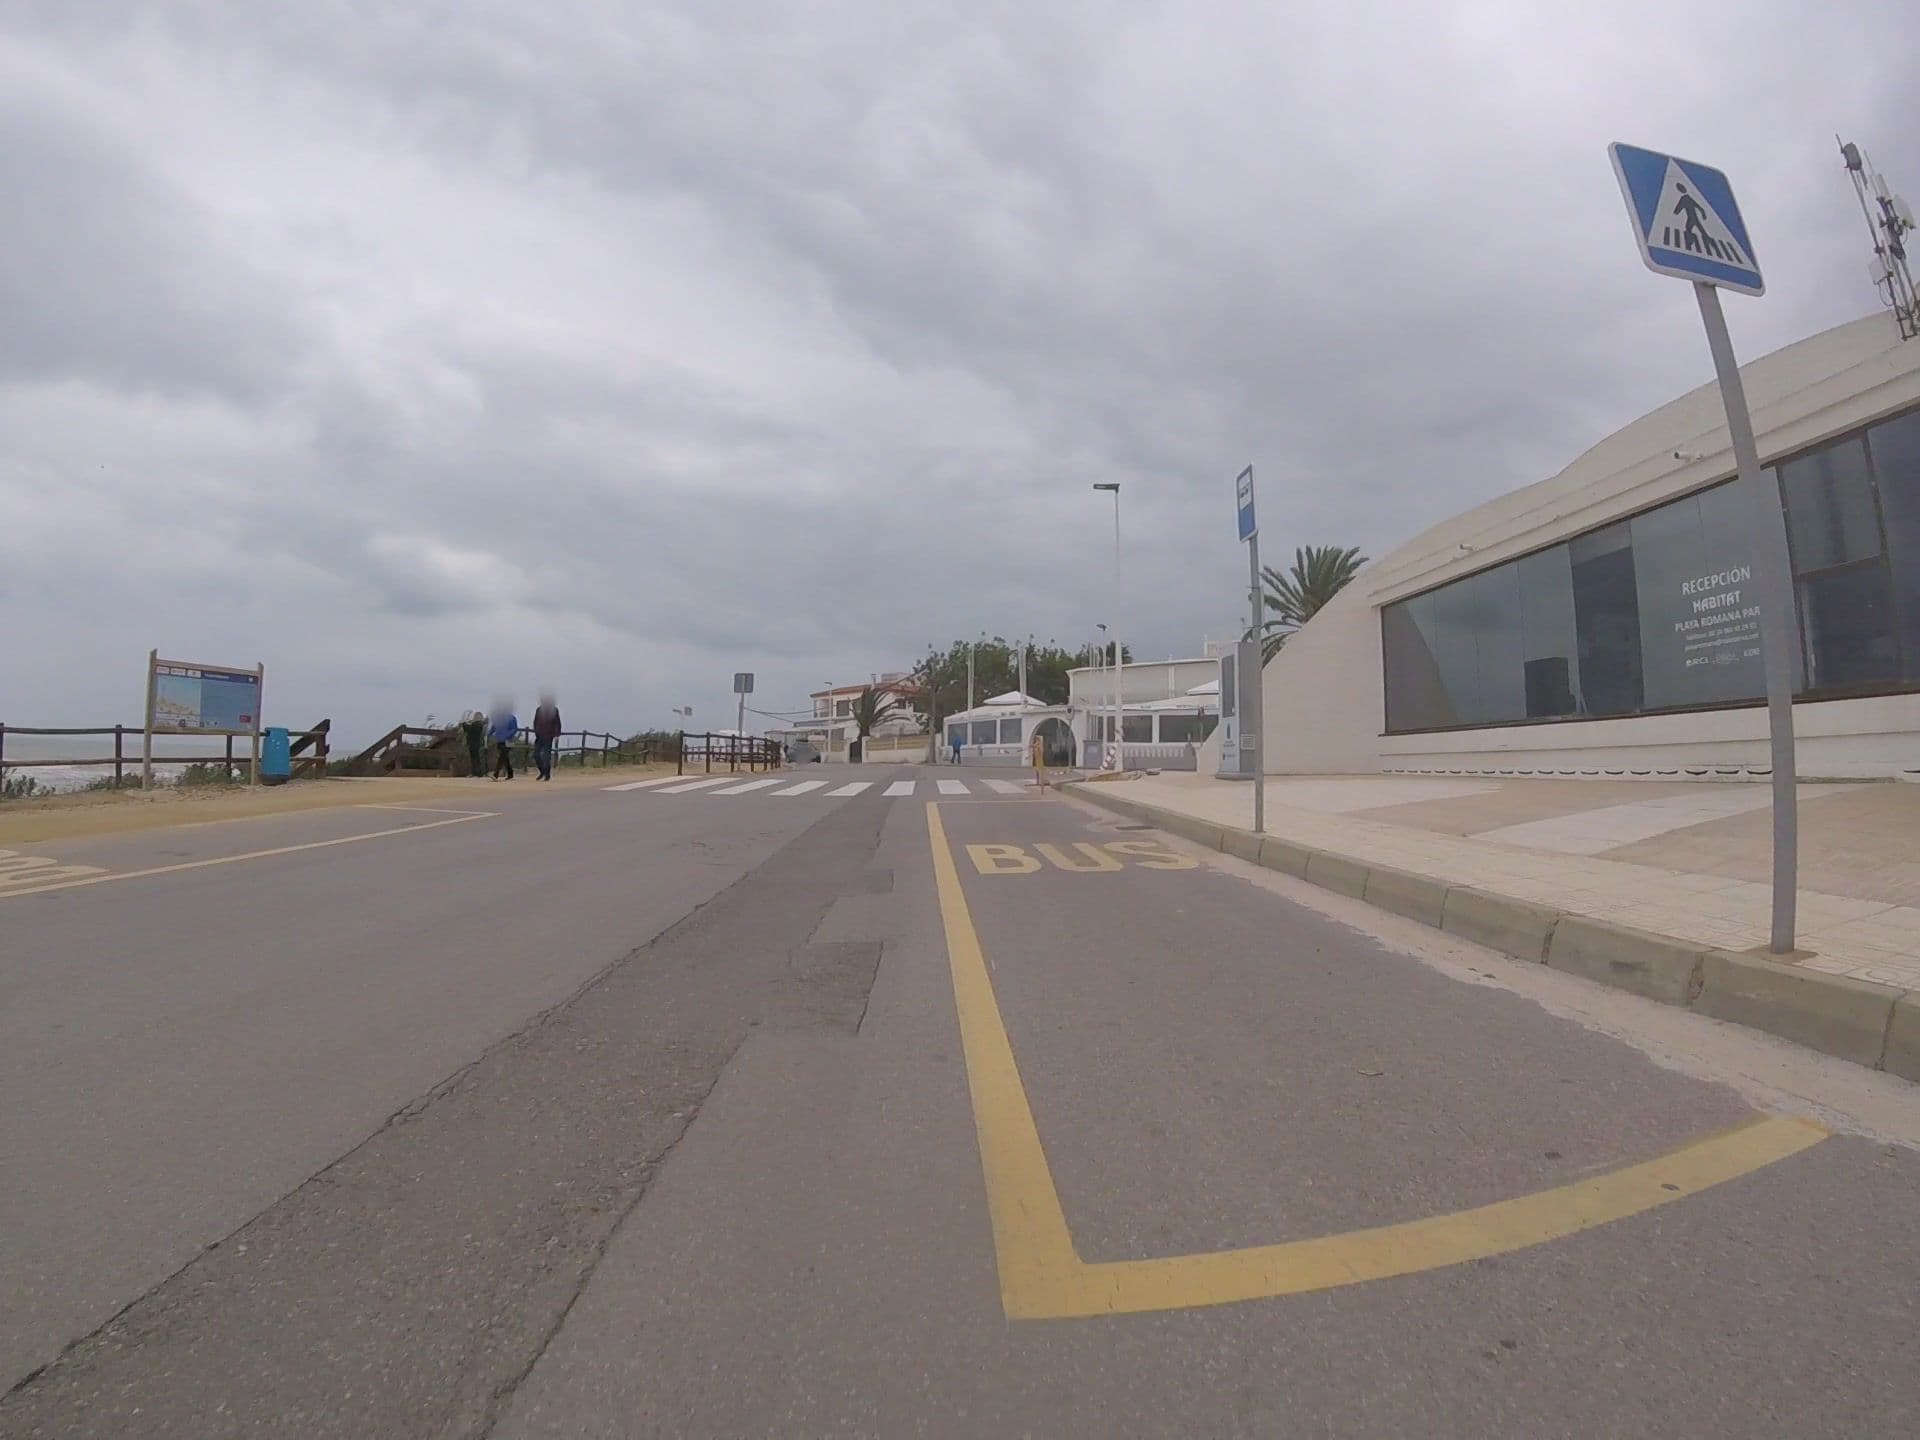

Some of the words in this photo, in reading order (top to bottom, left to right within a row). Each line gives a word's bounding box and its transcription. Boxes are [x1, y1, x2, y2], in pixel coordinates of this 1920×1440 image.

[1682, 565, 1751, 595] RECEPCIÓN
[1692, 590, 1741, 614] HABITAT
[1701, 610, 1741, 628] ROMANA
[1742, 606, 1761, 619] PAR
[965, 840, 1201, 874] BUS
